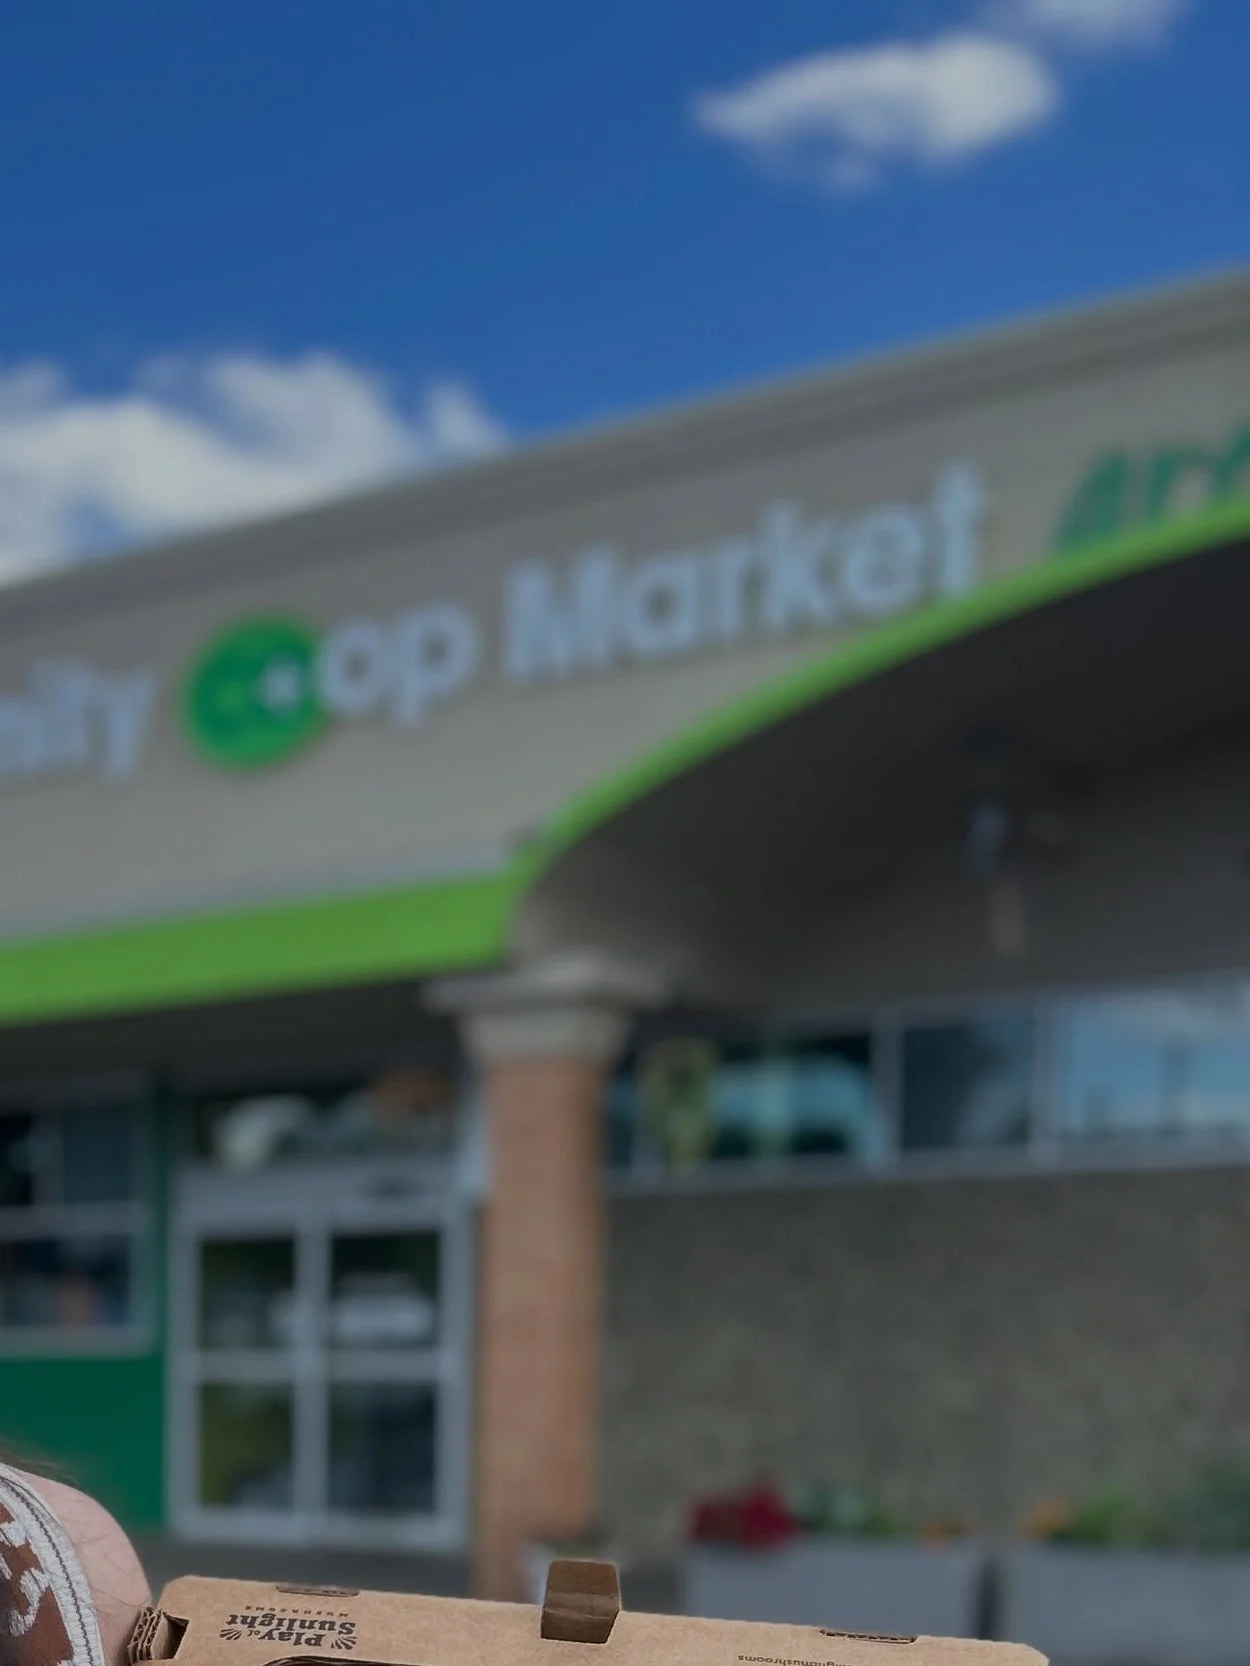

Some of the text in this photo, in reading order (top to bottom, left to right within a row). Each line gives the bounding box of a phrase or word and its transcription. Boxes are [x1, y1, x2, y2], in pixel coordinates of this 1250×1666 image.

[502, 458, 983, 686] Market
[245, 1605, 349, 1618] MUSHROOMS
[226, 1612, 356, 1635] Sunlight
[258, 1627, 326, 1647] Play
